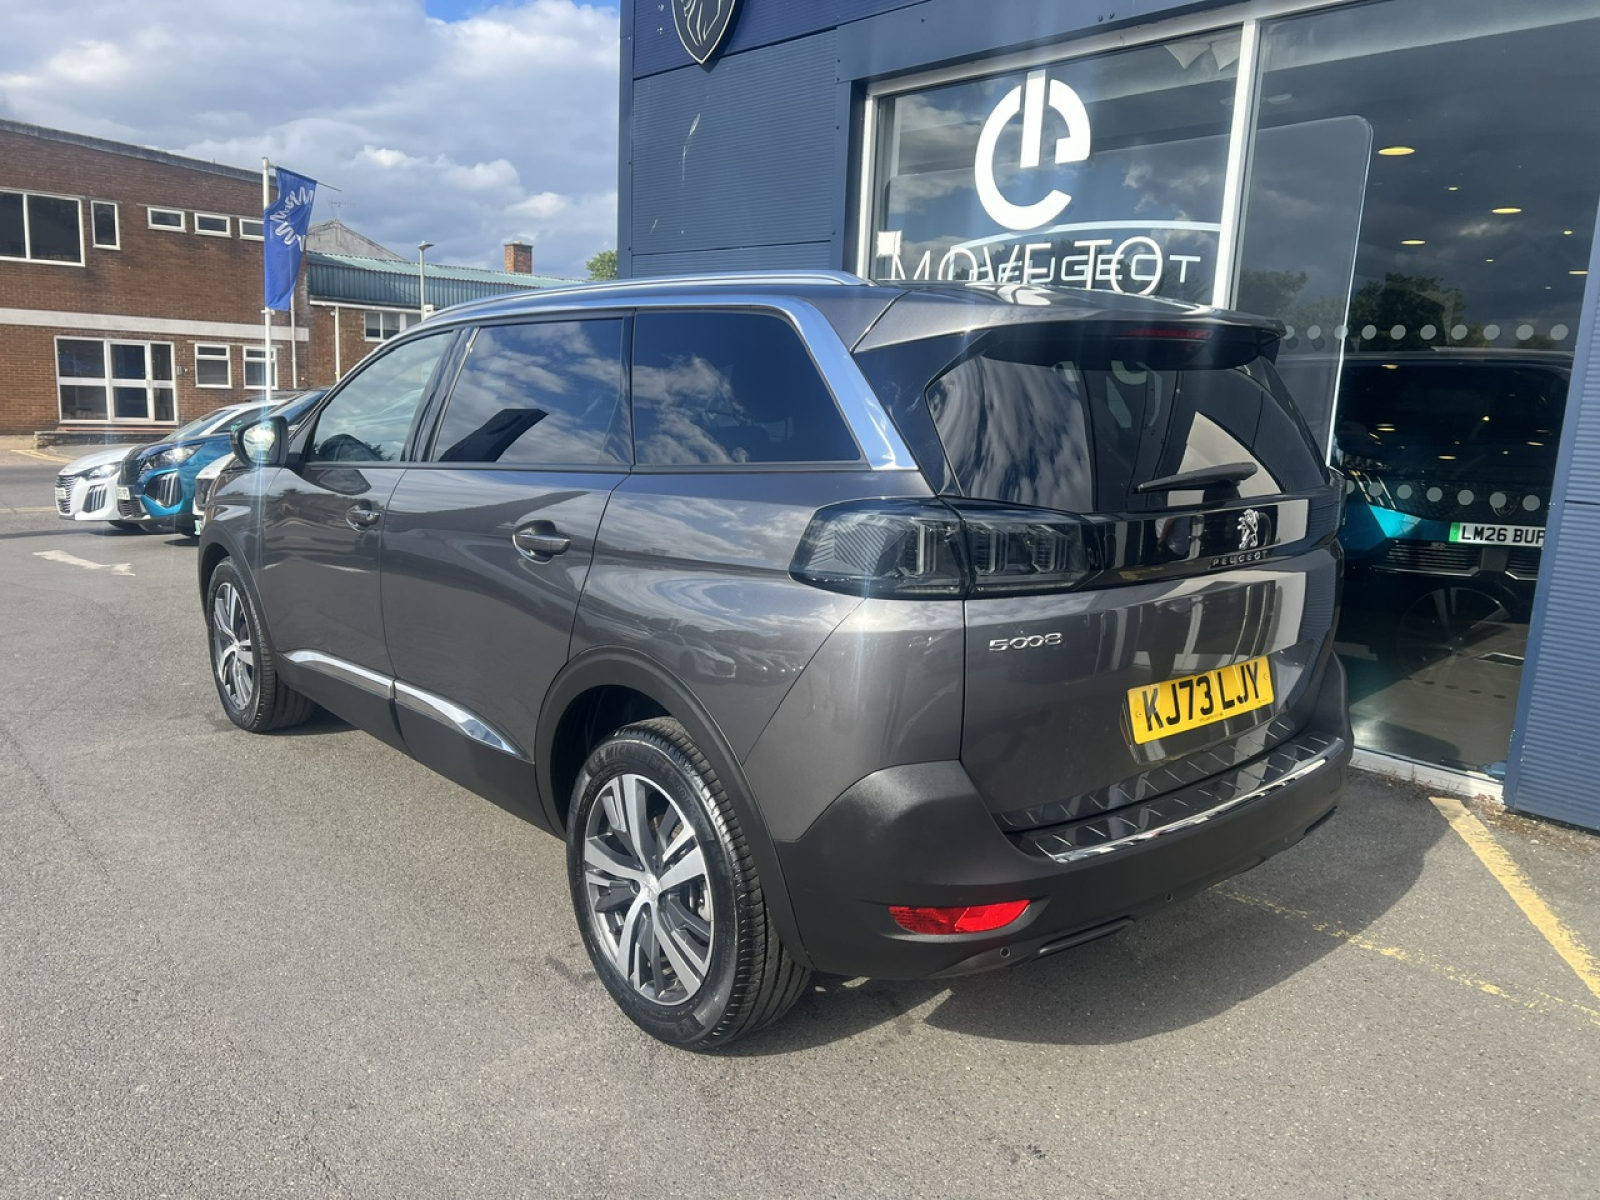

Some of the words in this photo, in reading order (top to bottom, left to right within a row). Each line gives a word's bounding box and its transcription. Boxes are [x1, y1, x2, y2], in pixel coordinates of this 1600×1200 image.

[891, 243, 1051, 284] MOVE
[1074, 236, 1163, 296] TO
[1461, 525, 1508, 542] LM26
[1212, 550, 1269, 567] PEUGEOT
[989, 632, 1063, 651] 5008
[1142, 675, 1214, 731] KJ73
[1217, 662, 1259, 710] LJY
